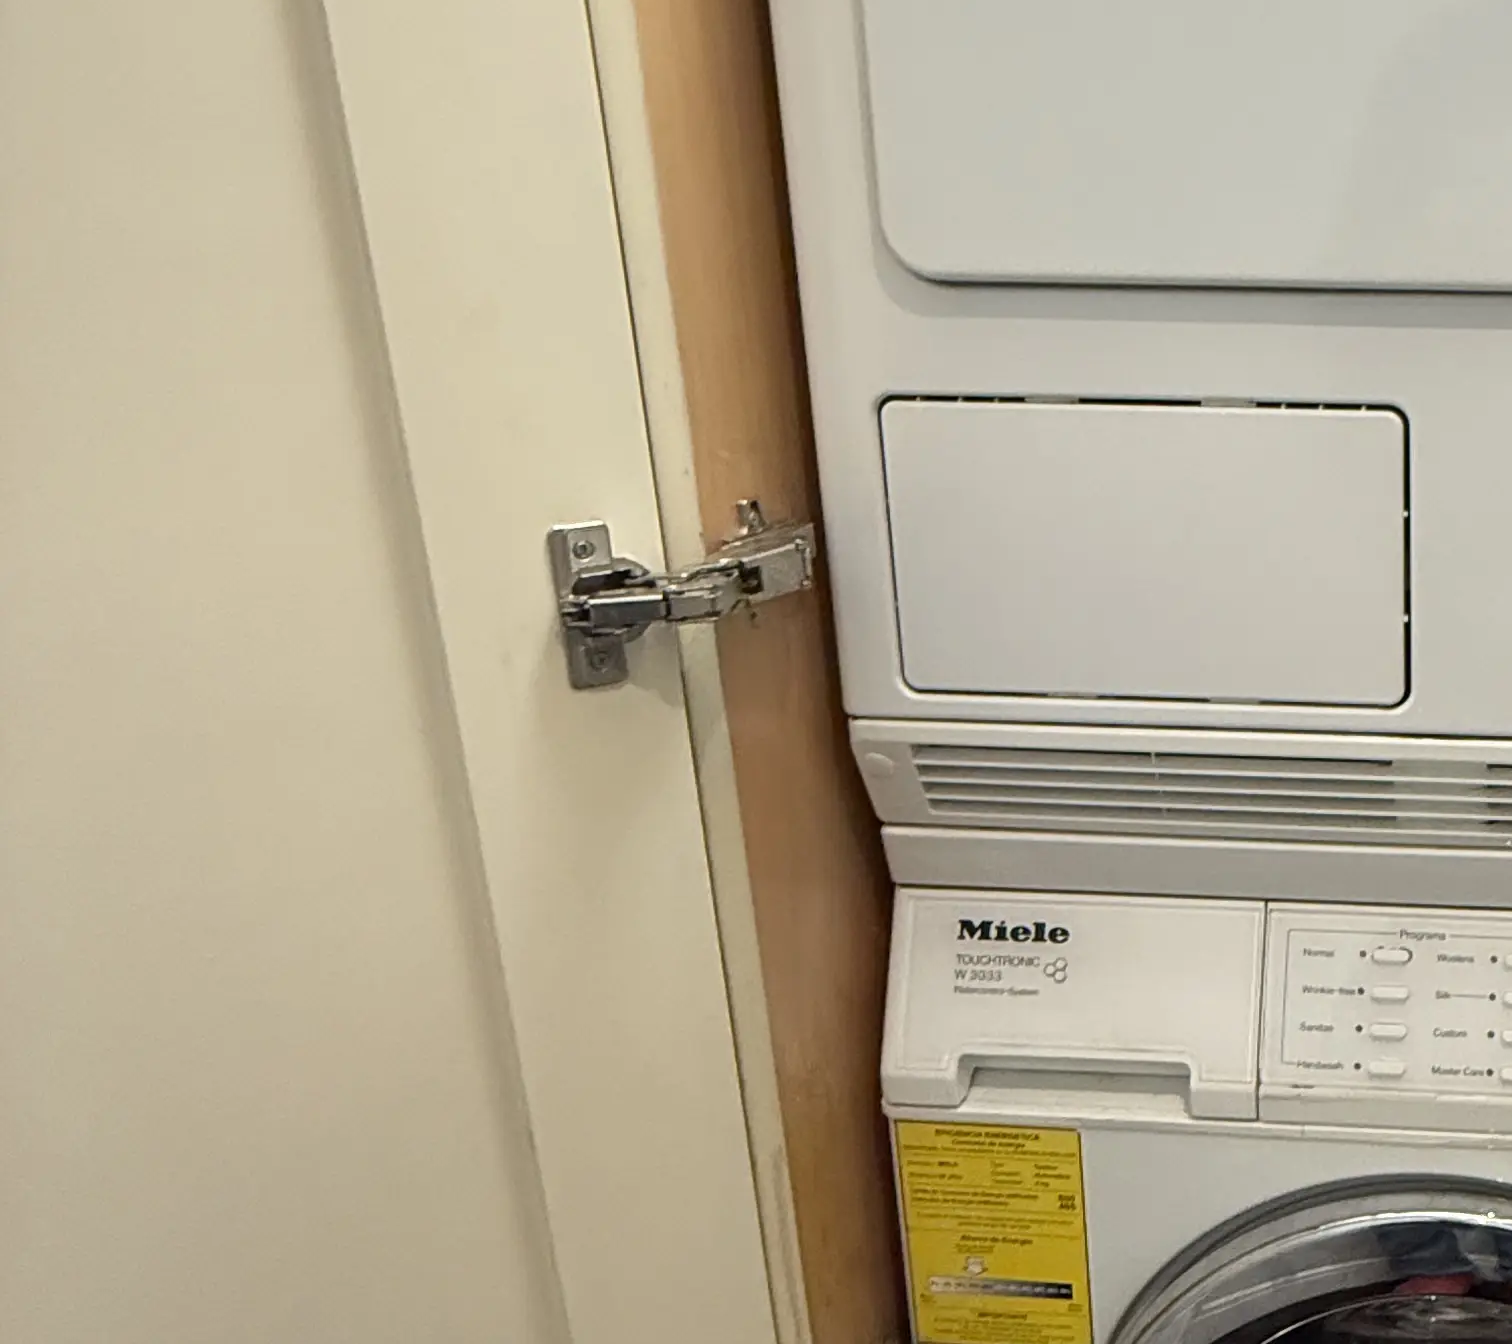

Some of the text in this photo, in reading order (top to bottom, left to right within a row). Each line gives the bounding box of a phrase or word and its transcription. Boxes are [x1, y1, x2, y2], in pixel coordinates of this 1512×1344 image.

[956, 919, 1070, 944] Miele
[1400, 929, 1446, 941] Programs
[956, 954, 1041, 967] TOUCHTRONIC
[954, 969, 967, 980] W
